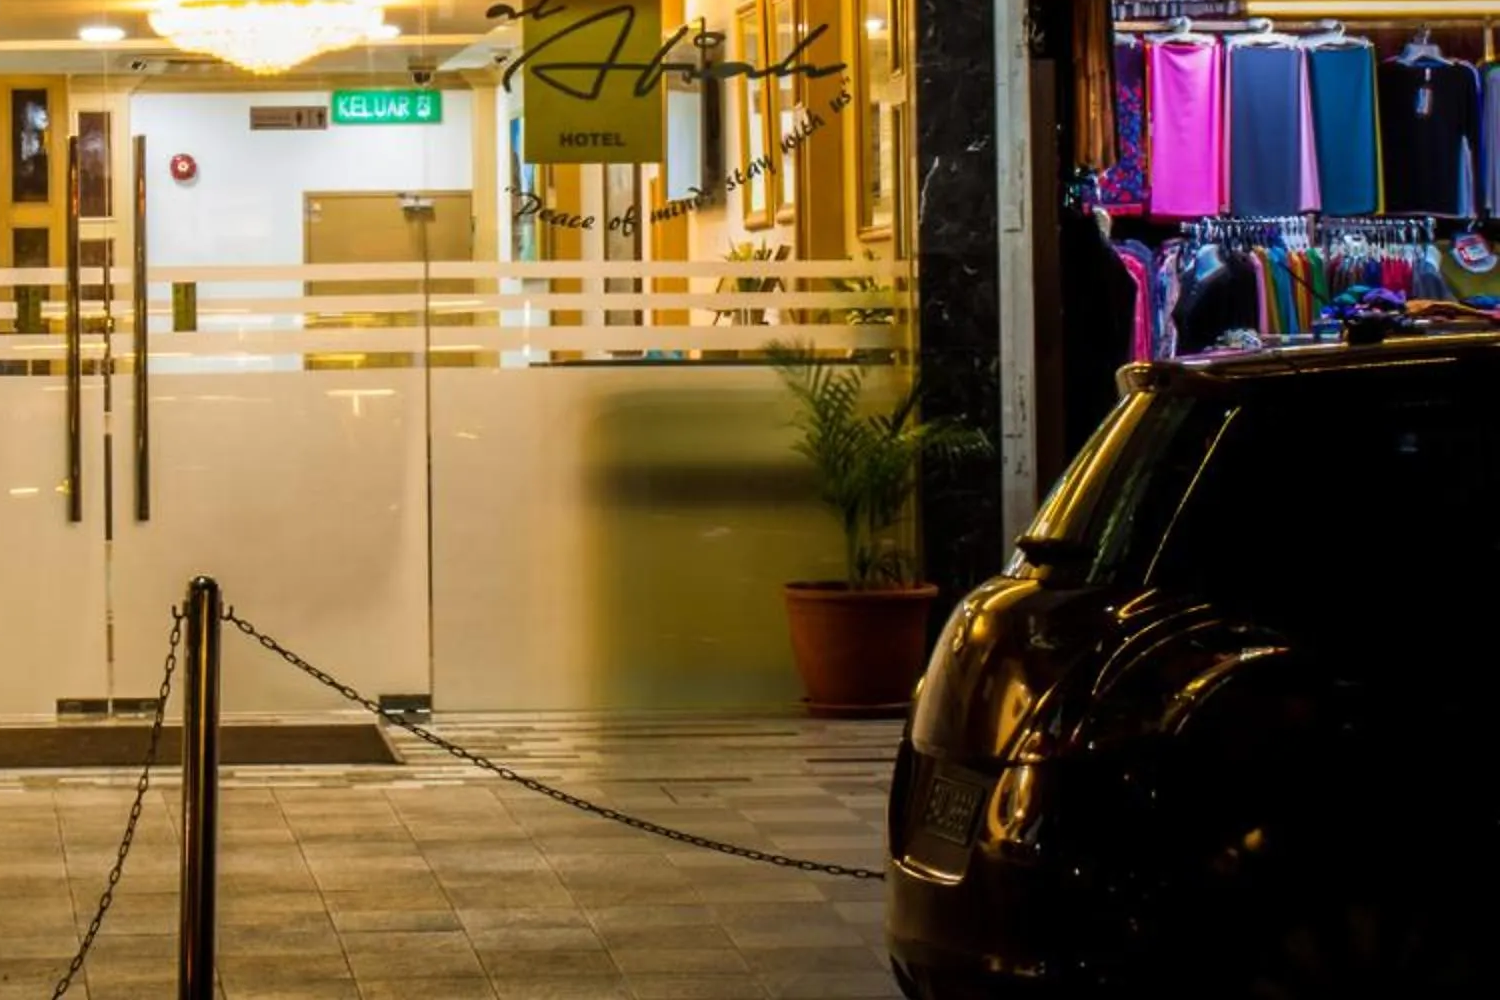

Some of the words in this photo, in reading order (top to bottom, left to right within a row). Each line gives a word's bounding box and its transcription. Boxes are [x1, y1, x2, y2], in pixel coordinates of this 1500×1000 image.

[338, 95, 410, 117] KELUAR
[559, 132, 628, 148] HOTEL
[608, 206, 636, 237] of
[726, 154, 776, 191] stay
[779, 107, 825, 156] with
